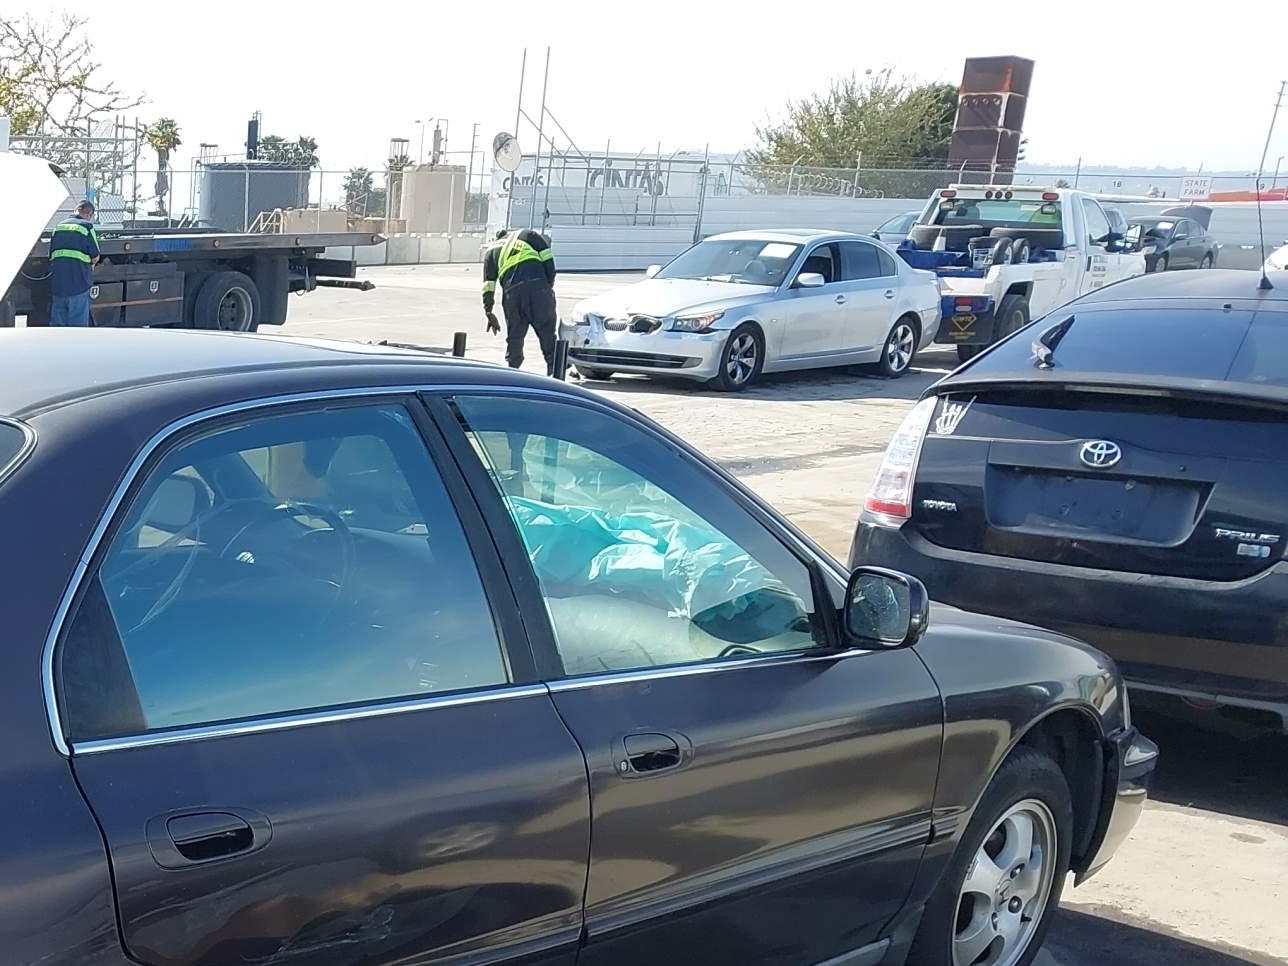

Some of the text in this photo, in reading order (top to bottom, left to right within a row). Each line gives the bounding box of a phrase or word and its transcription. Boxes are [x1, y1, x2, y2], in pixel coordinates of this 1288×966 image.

[502, 174, 545, 192] CNTAS
[1184, 179, 1208, 187] STATE
[922, 499, 958, 512] TOYOTA
[1215, 528, 1281, 543] PRIUS
